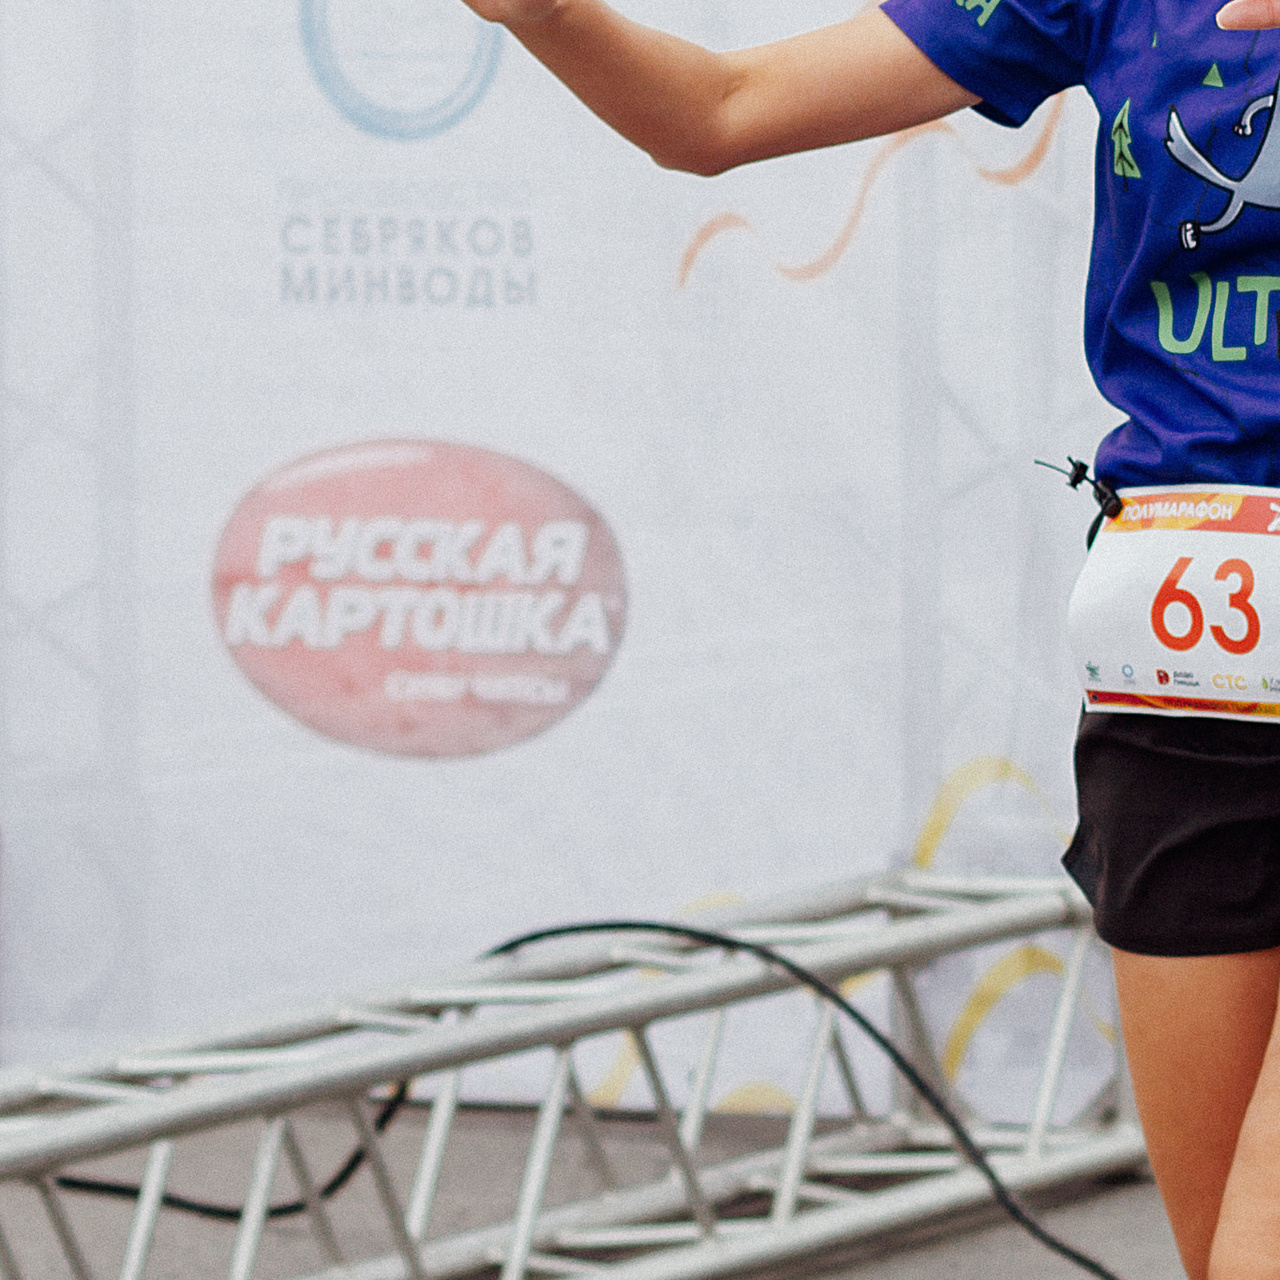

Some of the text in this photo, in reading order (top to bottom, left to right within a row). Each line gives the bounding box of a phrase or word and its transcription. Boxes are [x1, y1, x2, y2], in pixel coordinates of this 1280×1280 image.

[1121, 500, 1233, 522] ПОЛУМАРАФОН
[256, 516, 590, 586] РУССКАЯ
[226, 582, 612, 655] КАРТОШКА
[1151, 557, 1261, 655] 63
